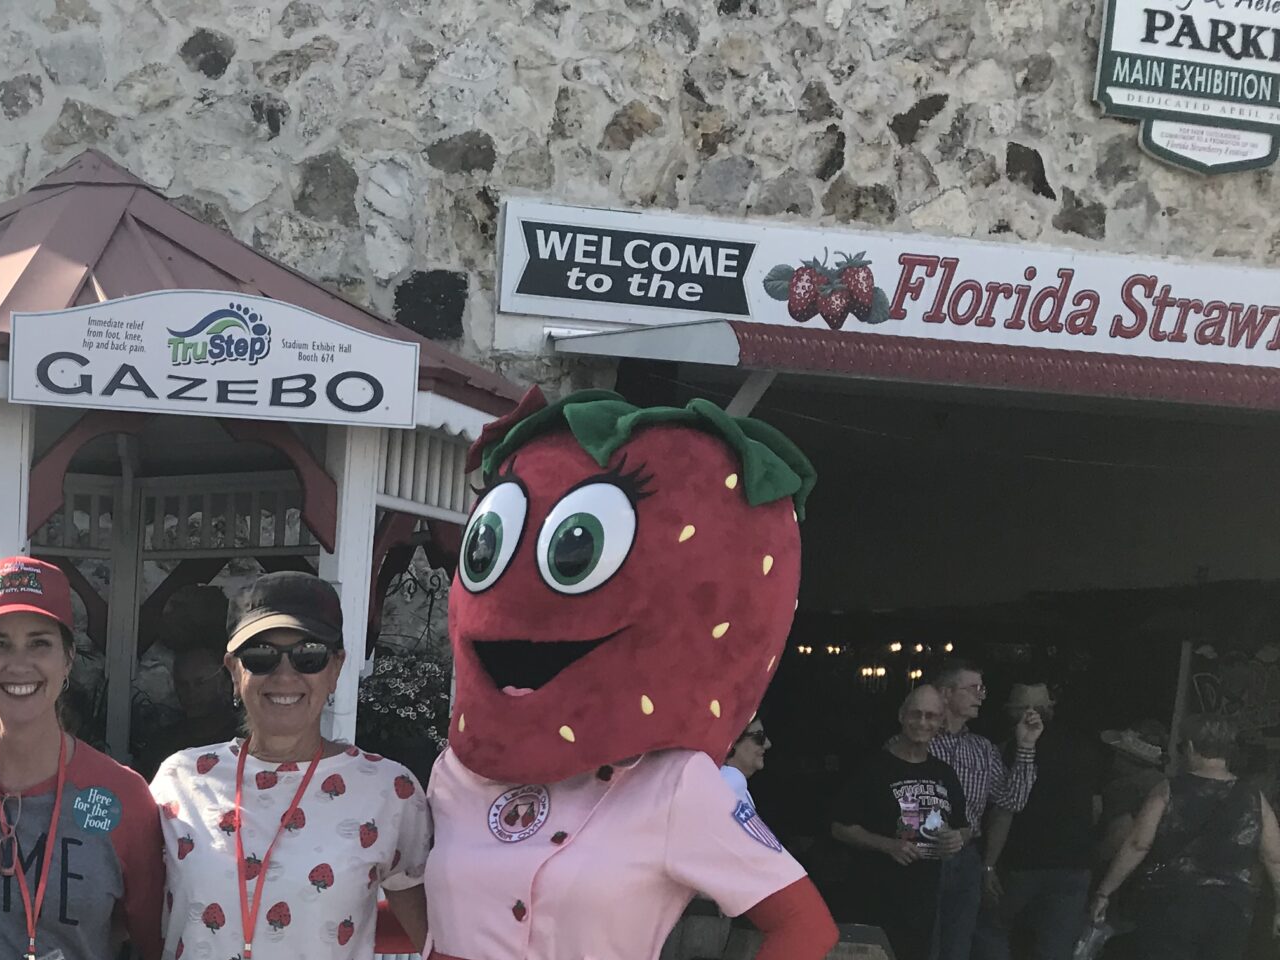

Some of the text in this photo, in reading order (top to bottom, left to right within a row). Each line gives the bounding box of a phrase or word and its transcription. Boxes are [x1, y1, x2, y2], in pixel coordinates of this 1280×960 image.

[1140, 8, 1280, 62] PARK
[1112, 56, 1272, 101] MAIN EXHIBITION
[1127, 92, 1210, 112] DEDICATED
[1219, 105, 1262, 119] APRIL
[535, 229, 740, 278] WELCOME
[567, 267, 703, 301] to the
[889, 252, 1101, 336] Florida
[88, 316, 144, 330] Immediate relief
[82, 338, 146, 354] hip and back pain.
[87, 328, 103, 338] from
[124, 331, 142, 343] knee,
[281, 338, 352, 354] Stadium Exhibit Hall
[167, 334, 270, 365] TruStep
[298, 351, 318, 363] Booth
[36, 351, 384, 413] GAZEBO
[73, 796, 108, 817] for the
[88, 788, 112, 806] Here
[83, 813, 111, 831] Food!
